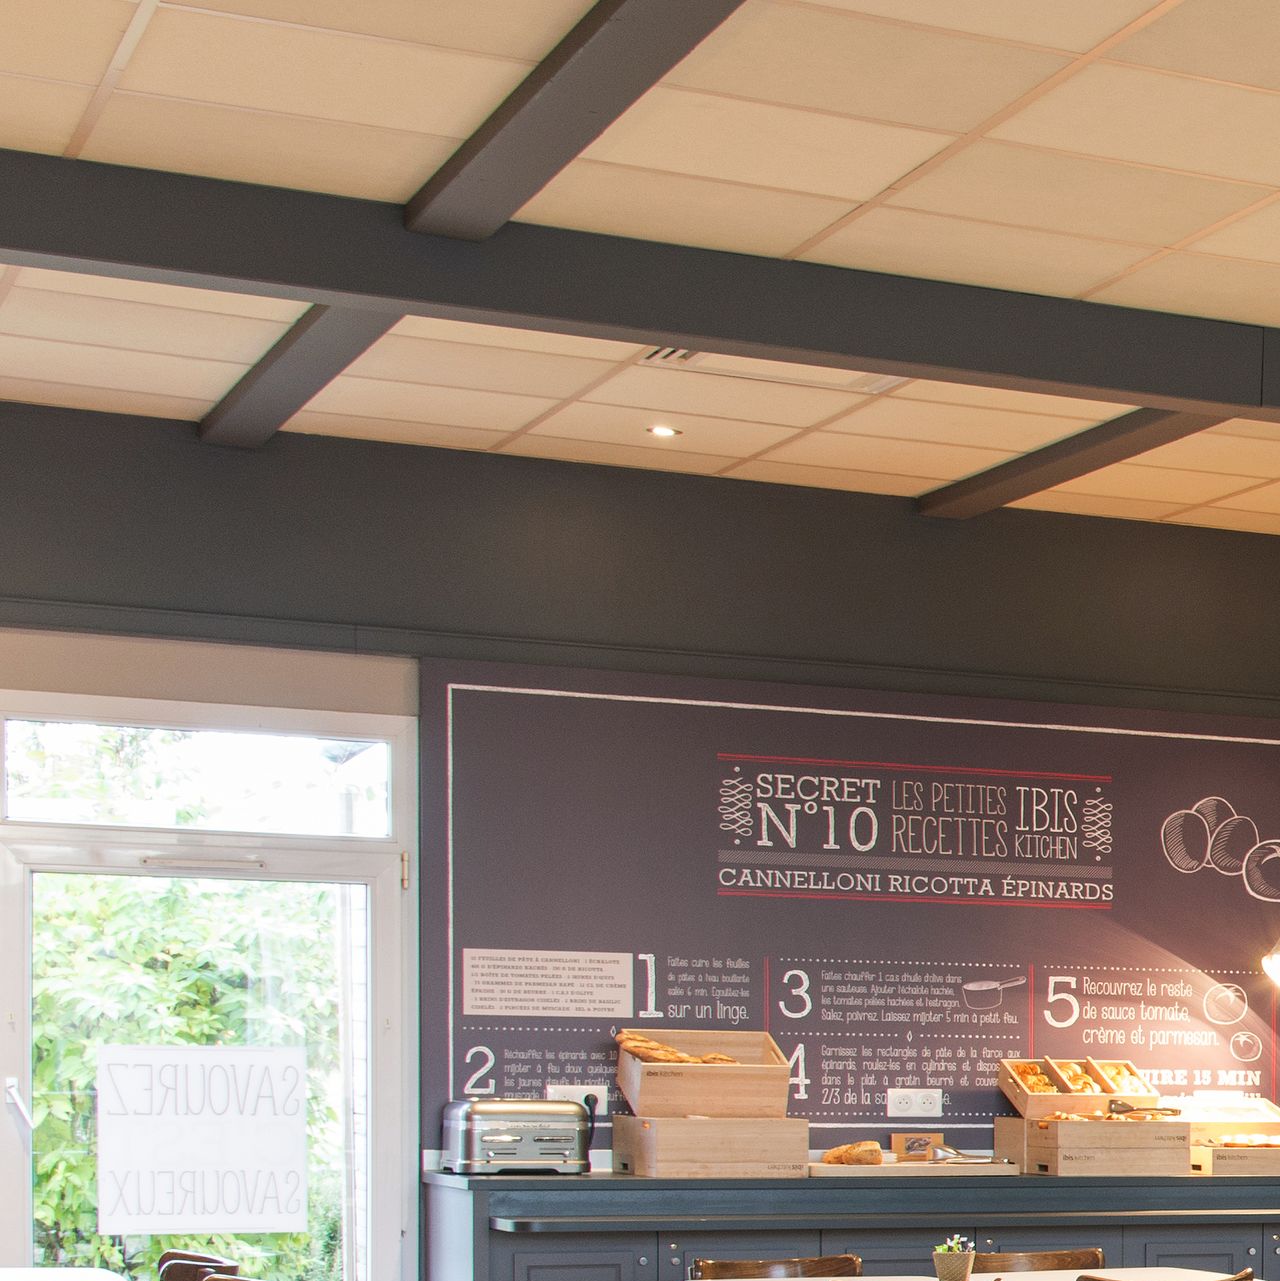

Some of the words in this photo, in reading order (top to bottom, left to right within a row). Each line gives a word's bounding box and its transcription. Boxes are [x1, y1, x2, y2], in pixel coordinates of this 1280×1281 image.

[756, 773, 881, 803] SECRET
[892, 780, 924, 811] LES
[931, 785, 1007, 815] PETITES
[1015, 786, 1078, 834] IBIS
[757, 801, 878, 852] N°10
[891, 814, 1008, 858] RECETTES
[1014, 834, 1078, 860] KITCHEN
[718, 868, 882, 892] CANNELLONI
[888, 874, 996, 897] RICOTTA
[1001, 875, 1114, 901] ÉPINARDS
[638, 953, 664, 1018] 1
[779, 970, 812, 1018] 3
[1083, 977, 1143, 997] Recouvrez
[1146, 978, 1157, 997] le
[1160, 979, 1193, 998] reste
[668, 1004, 691, 1018] sur
[695, 1005, 712, 1019] un
[717, 1000, 750, 1025] linge.
[1043, 976, 1080, 1028] 5
[1083, 1000, 1097, 1020] de
[1101, 1004, 1135, 1020] sauce
[1140, 1001, 1191, 1023] tomate,
[881, 1011, 910, 1021] Laissez
[913, 1012, 943, 1025] mijoter
[946, 1012, 951, 1022] 5
[954, 1012, 969, 1022] min
[980, 1012, 1000, 1026] petit
[1083, 1026, 1126, 1045] crème
[1130, 1027, 1145, 1045] et
[1150, 1030, 1220, 1050] parmesan.
[821, 1045, 857, 1056] Garnissez
[862, 1045, 872, 1056] les
[877, 1045, 917, 1060] rectangles
[922, 1046, 931, 1057] de
[935, 1047, 952, 1060] pâte
[957, 1046, 966, 1057] de
[970, 1046, 977, 1058] la
[982, 1047, 1003, 1058] farce
[1007, 1050, 1021, 1058] aux
[862, 1059, 900, 1071] roulez-les
[906, 1062, 916, 1071] en
[922, 1059, 956, 1074] cylindres
[962, 1060, 971, 1071] et
[464, 1046, 496, 1095] 2
[789, 1043, 811, 1099] 4
[821, 1074, 841, 1085] dans
[847, 1074, 854, 1086] le
[861, 1074, 877, 1089] plat
[883, 1075, 889, 1086] à
[960, 1075, 969, 1086] et
[1139, 1069, 1188, 1086] UIRE
[1193, 1069, 1212, 1086] 15
[1217, 1069, 1262, 1087] MIN
[822, 1089, 840, 1105] 2/3
[844, 1089, 857, 1105] de
[861, 1089, 872, 1104] la
